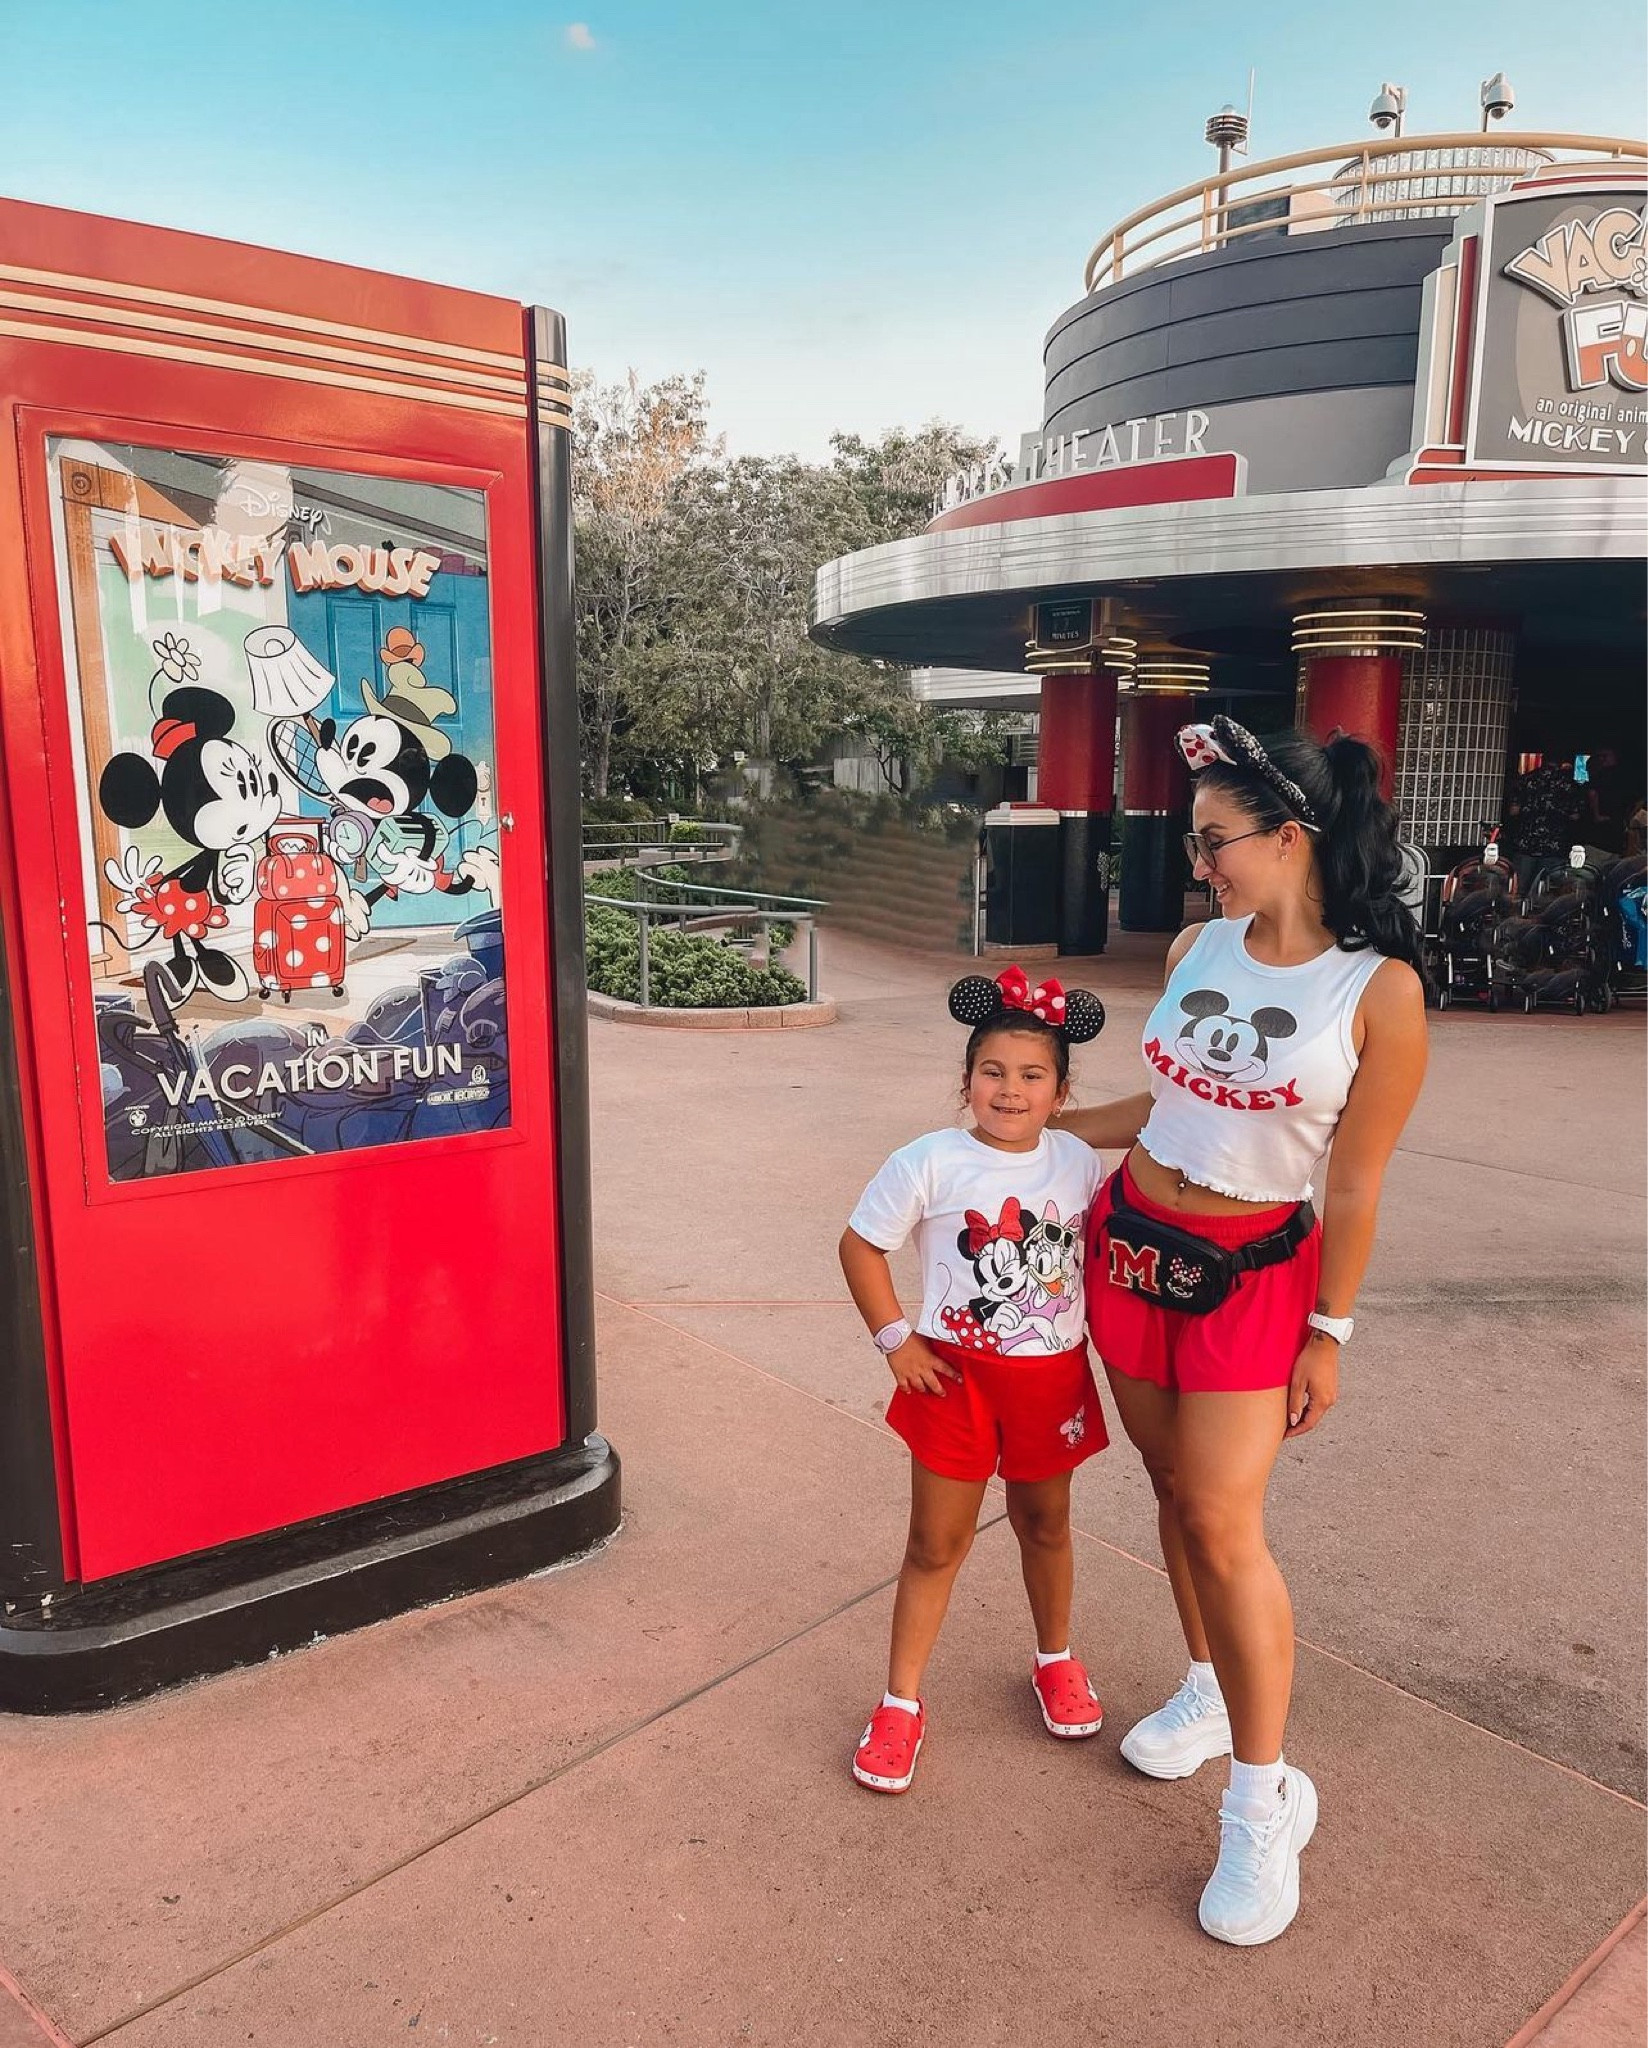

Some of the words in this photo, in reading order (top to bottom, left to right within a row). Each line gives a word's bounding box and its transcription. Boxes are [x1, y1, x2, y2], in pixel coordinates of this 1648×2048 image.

[1503, 206, 1648, 305] VAC
[1507, 415, 1636, 454] MICKEY
[1536, 398, 1553, 413] an
[1559, 400, 1613, 424] original
[1027, 410, 1210, 479] THEATER
[109, 523, 287, 586] MICKEY
[286, 539, 441, 598] MOUSE
[306, 1030, 328, 1048] IN
[157, 1051, 379, 1106] VACATION
[394, 1042, 463, 1080] FUN
[1144, 1036, 1304, 1110] MICKEY
[130, 1121, 196, 1136] COPYRIGHT
[153, 1130, 173, 1139] ALL
[175, 1126, 214, 1138] RIGHTS
[216, 1119, 268, 1131] RESERVED
[1108, 1237, 1162, 1296] M
